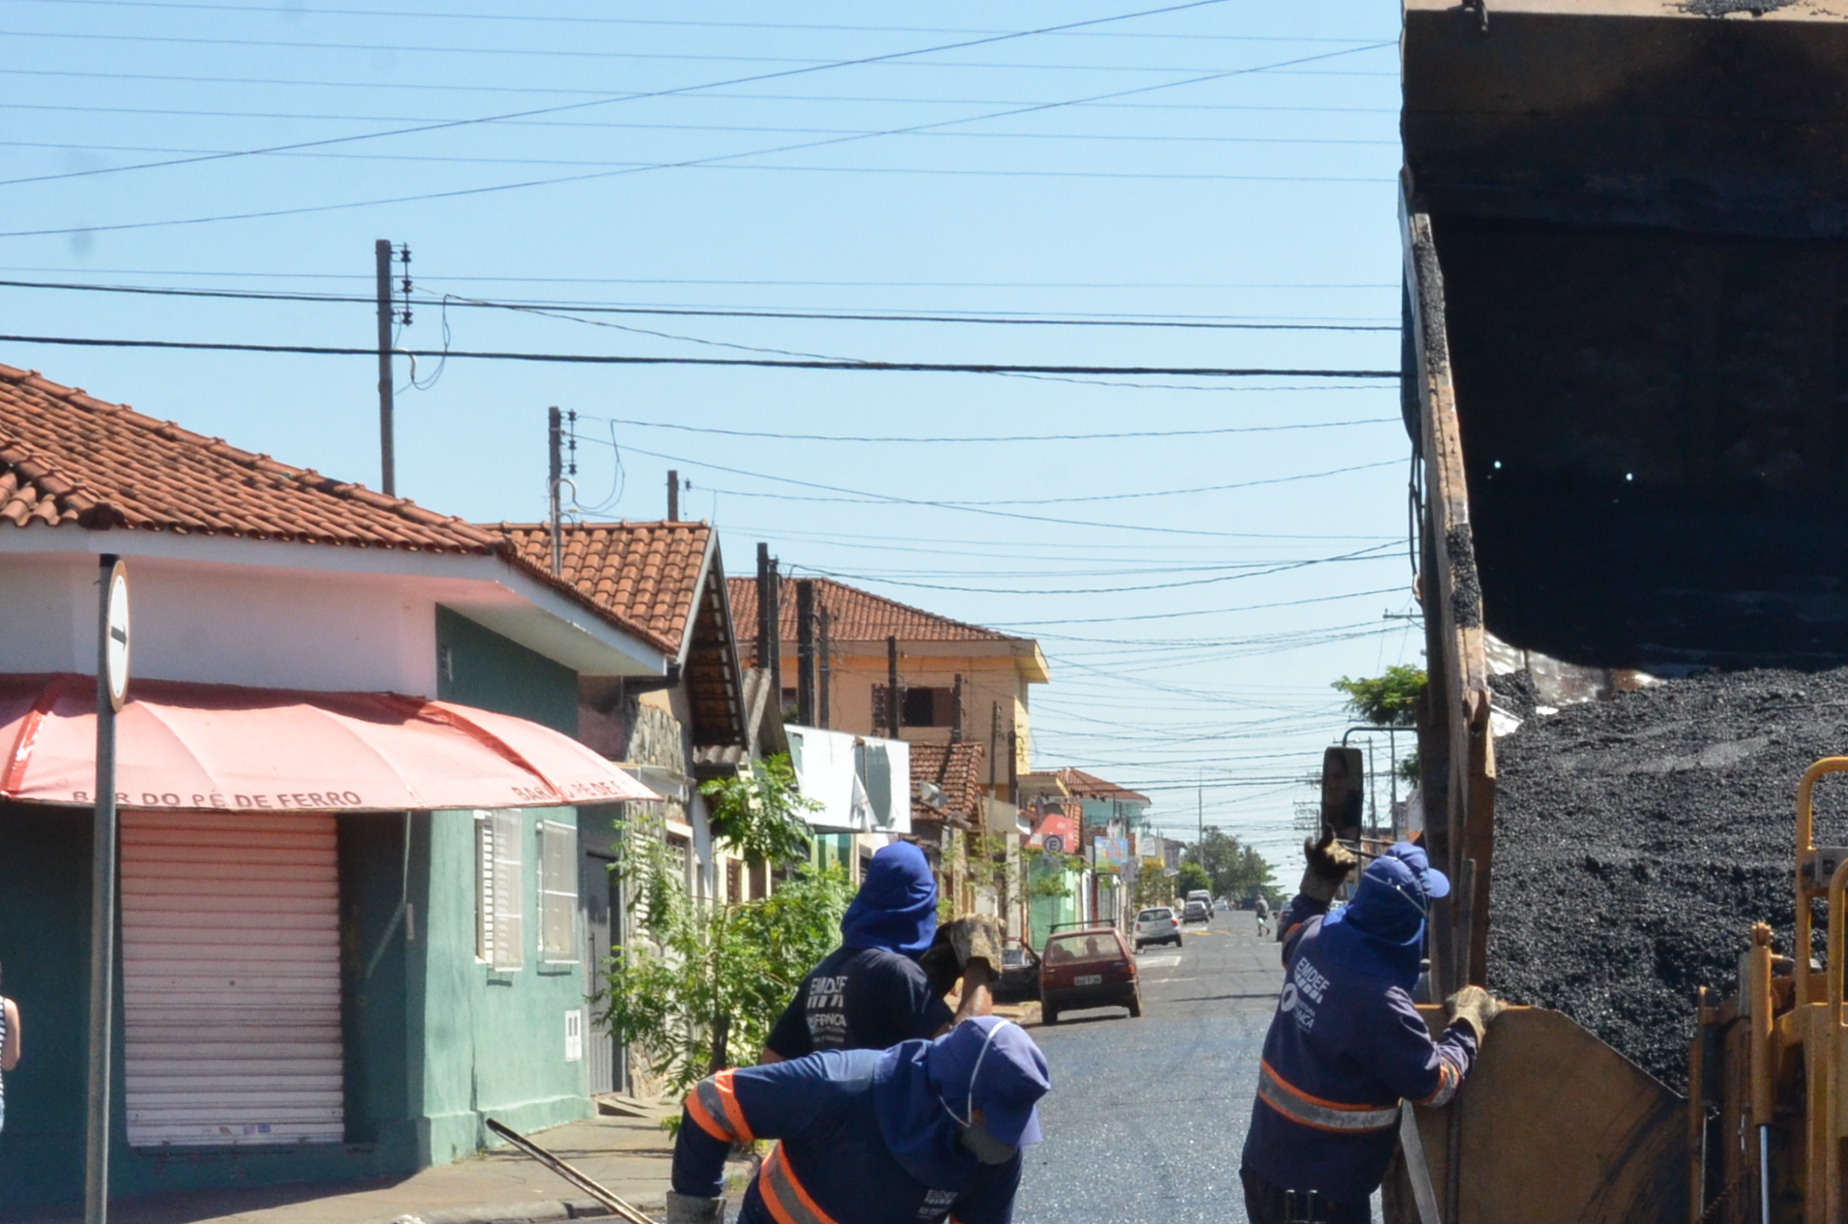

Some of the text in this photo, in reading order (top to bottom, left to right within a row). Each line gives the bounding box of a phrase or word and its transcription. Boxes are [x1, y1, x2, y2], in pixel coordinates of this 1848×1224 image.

[72, 791, 132, 804] BR
[141, 792, 181, 806] DO
[234, 794, 272, 808] DE
[277, 790, 362, 808] FERRO
[1296, 956, 1331, 992] EMDEF
